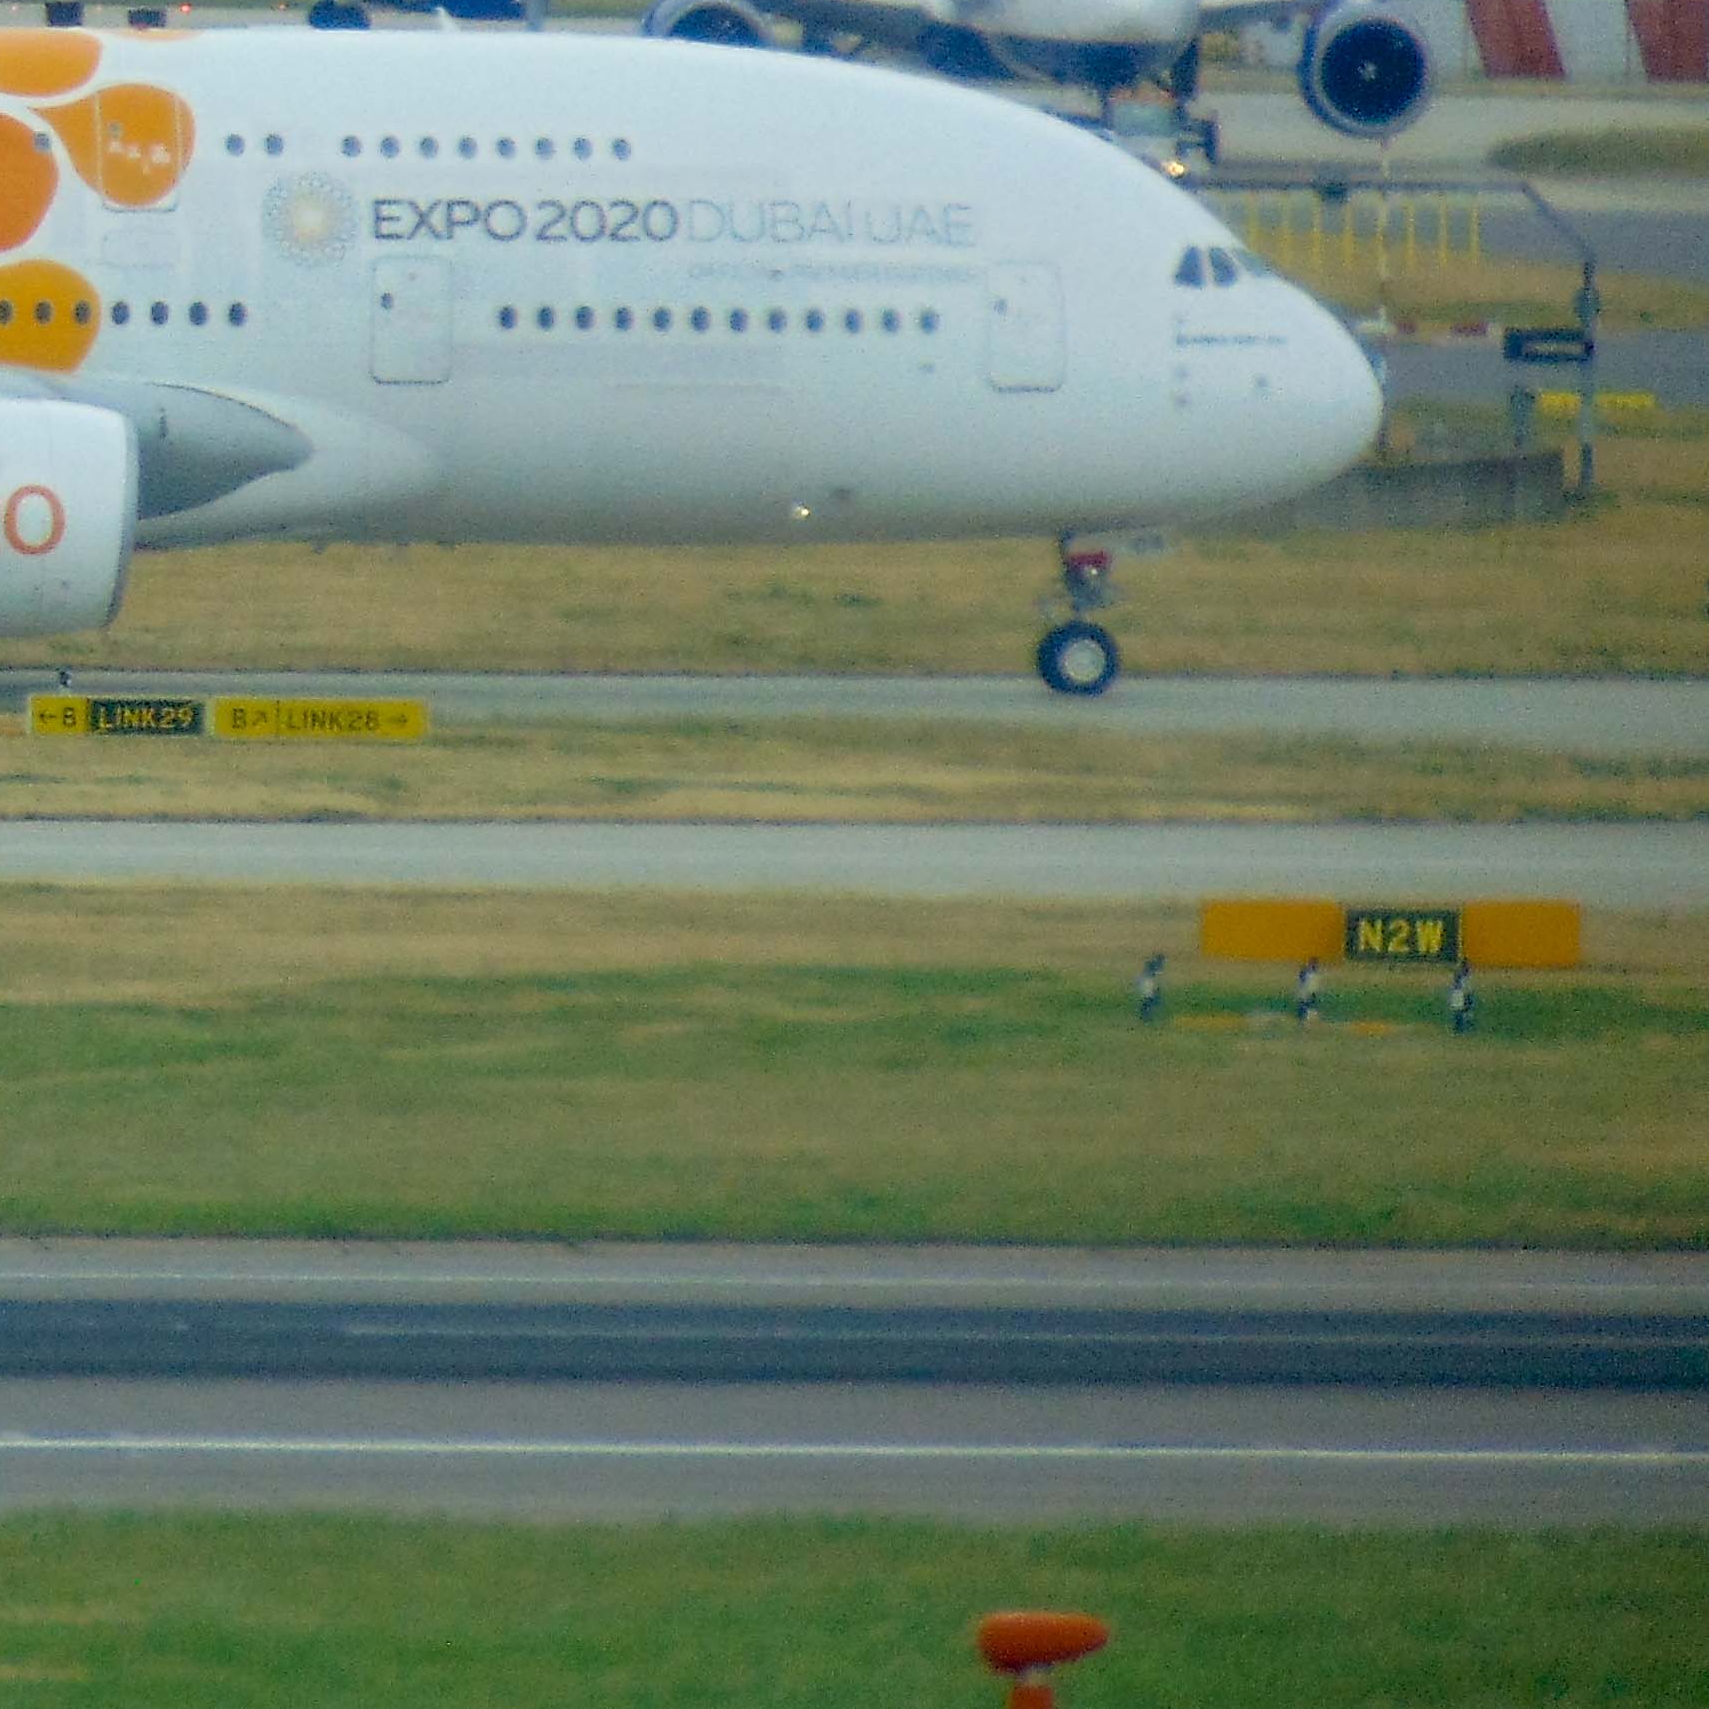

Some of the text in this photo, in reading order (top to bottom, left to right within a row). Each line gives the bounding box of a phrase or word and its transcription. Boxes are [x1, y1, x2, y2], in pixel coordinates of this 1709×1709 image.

[373, 198, 976, 247] EXPO 2020 DUBAI UAE
[232, 707, 247, 729] B
[1358, 918, 1444, 953] N2W
